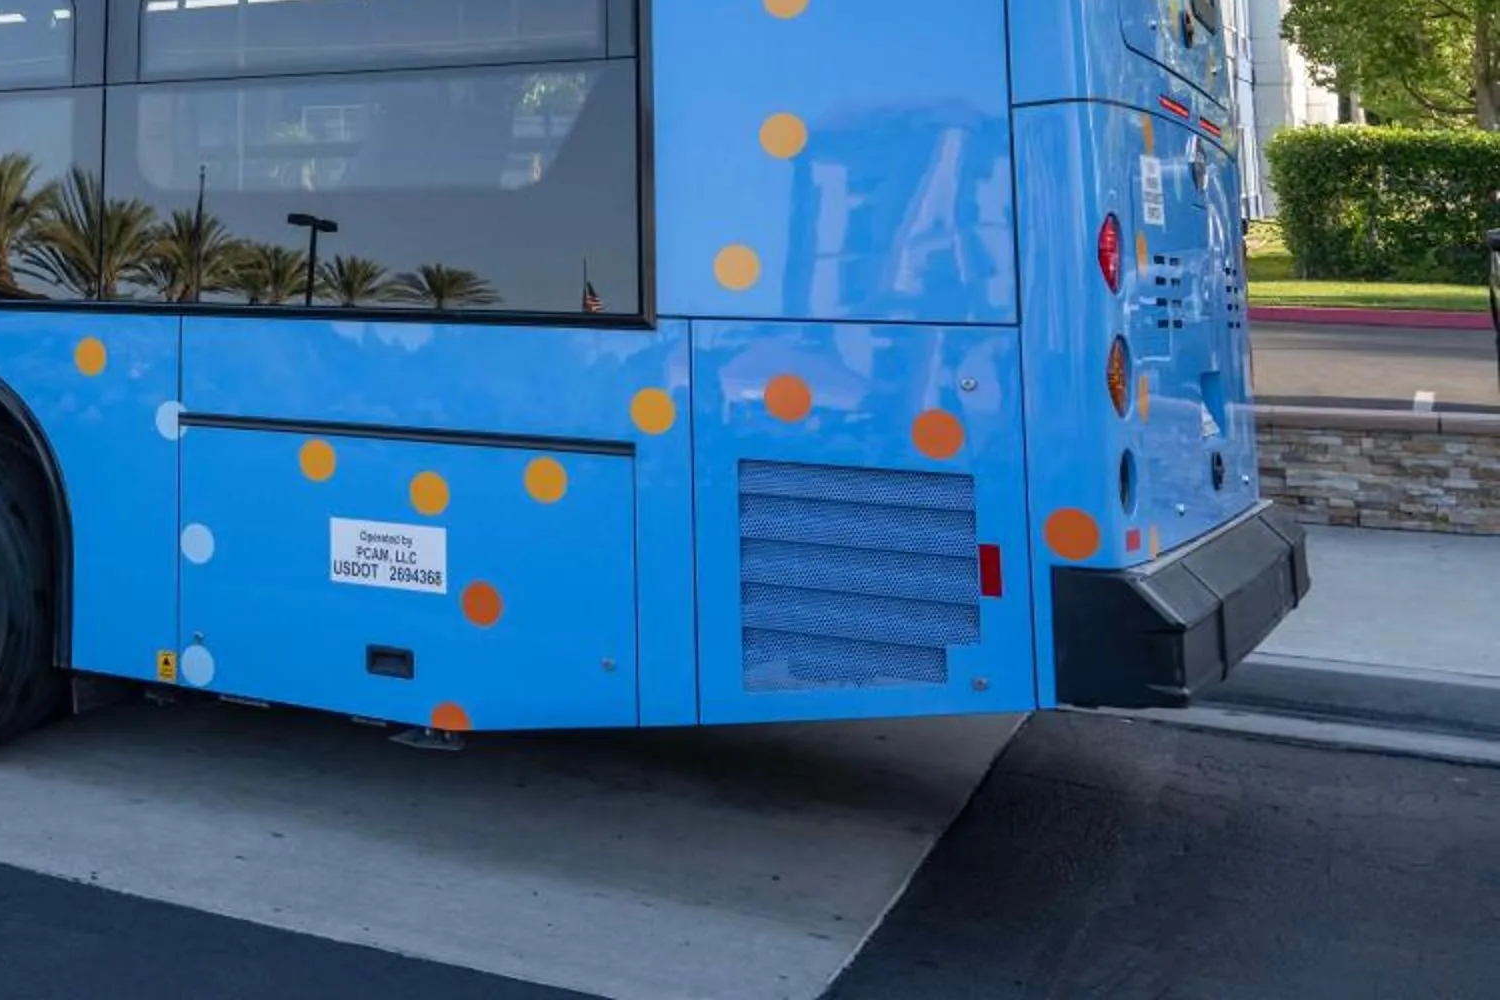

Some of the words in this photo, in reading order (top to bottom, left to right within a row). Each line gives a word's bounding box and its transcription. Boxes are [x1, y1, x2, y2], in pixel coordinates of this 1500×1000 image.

[401, 534, 413, 548] by
[395, 549, 418, 565] LLC
[333, 559, 379, 579] USDOT
